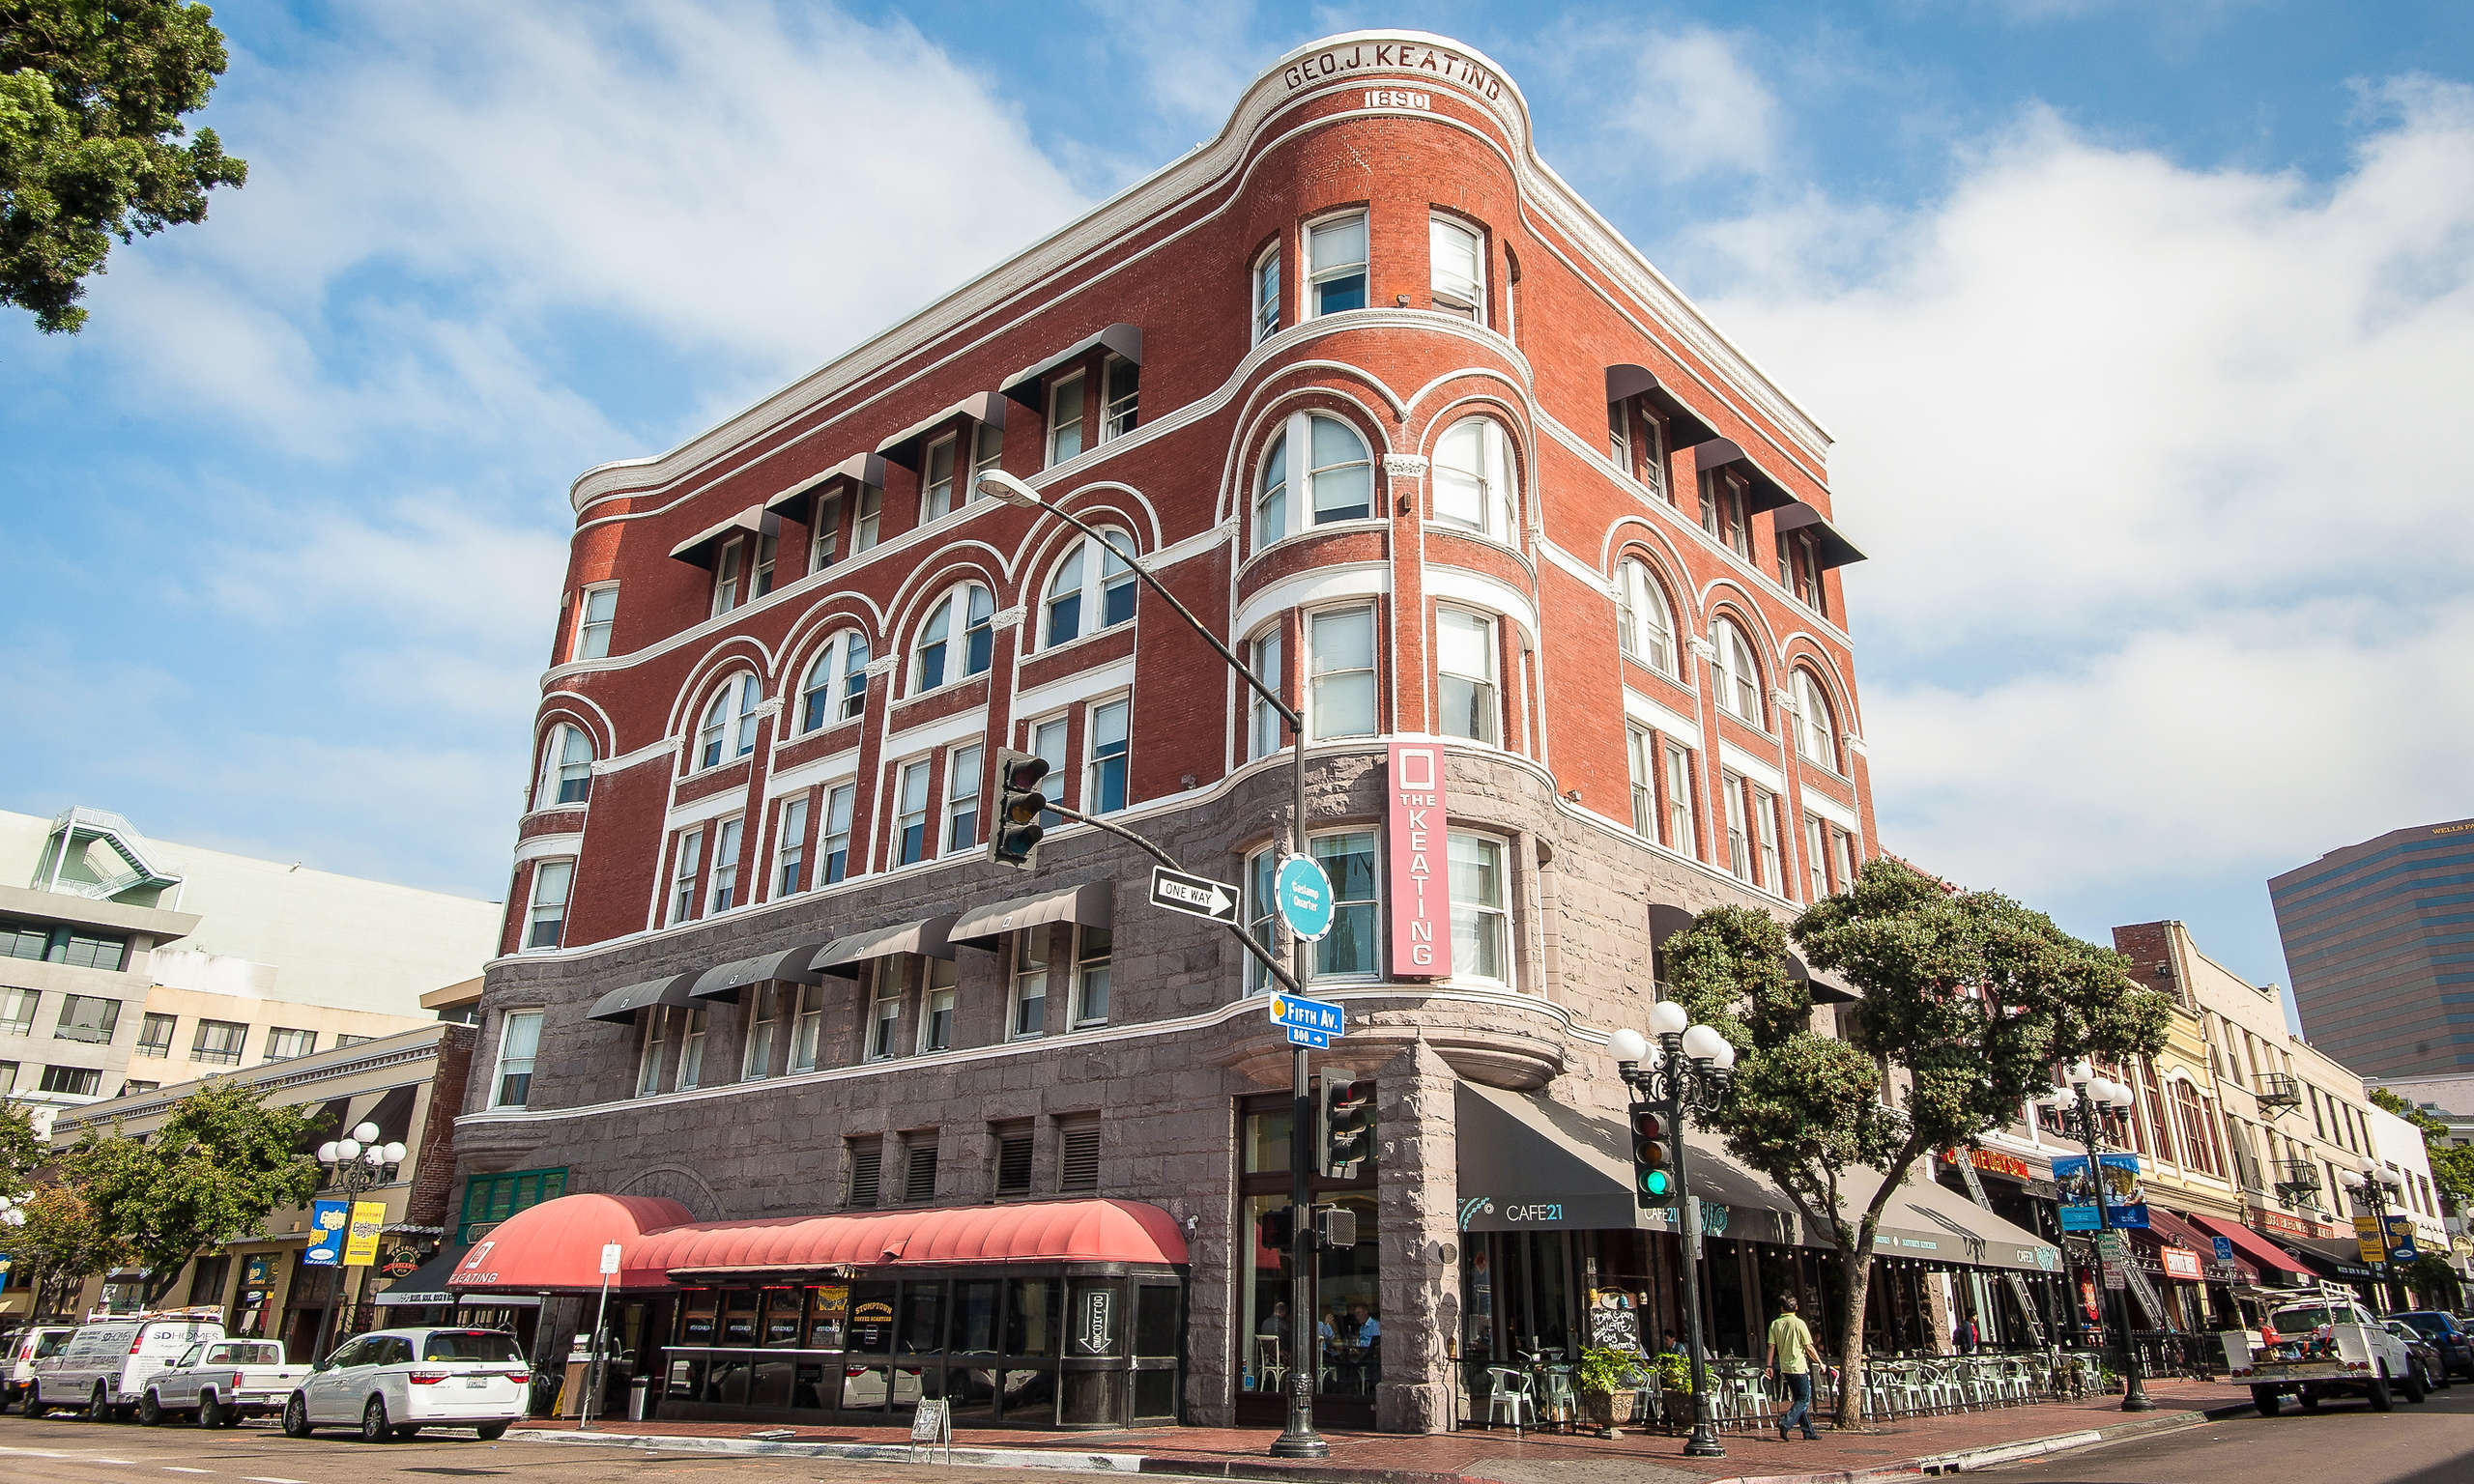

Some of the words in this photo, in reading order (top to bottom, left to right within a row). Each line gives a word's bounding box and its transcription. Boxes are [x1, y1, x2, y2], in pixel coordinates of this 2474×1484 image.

[1375, 44, 1501, 100] KEATING
[1366, 91, 1426, 109] 1890
[1399, 793, 1437, 807] THE
[2431, 826, 2464, 835] WELLS
[1165, 883, 1187, 899] ONE
[1191, 889, 1212, 905] WAY
[1290, 880, 1319, 900] Gaslamp
[1408, 808, 1433, 966] KEATING
[1293, 895, 1318, 912] Quarter
[1287, 1002, 1317, 1026] FIFTH
[1506, 1204, 1563, 1221] CAFE21
[855, 1301, 893, 1315] STUMPTOWN
